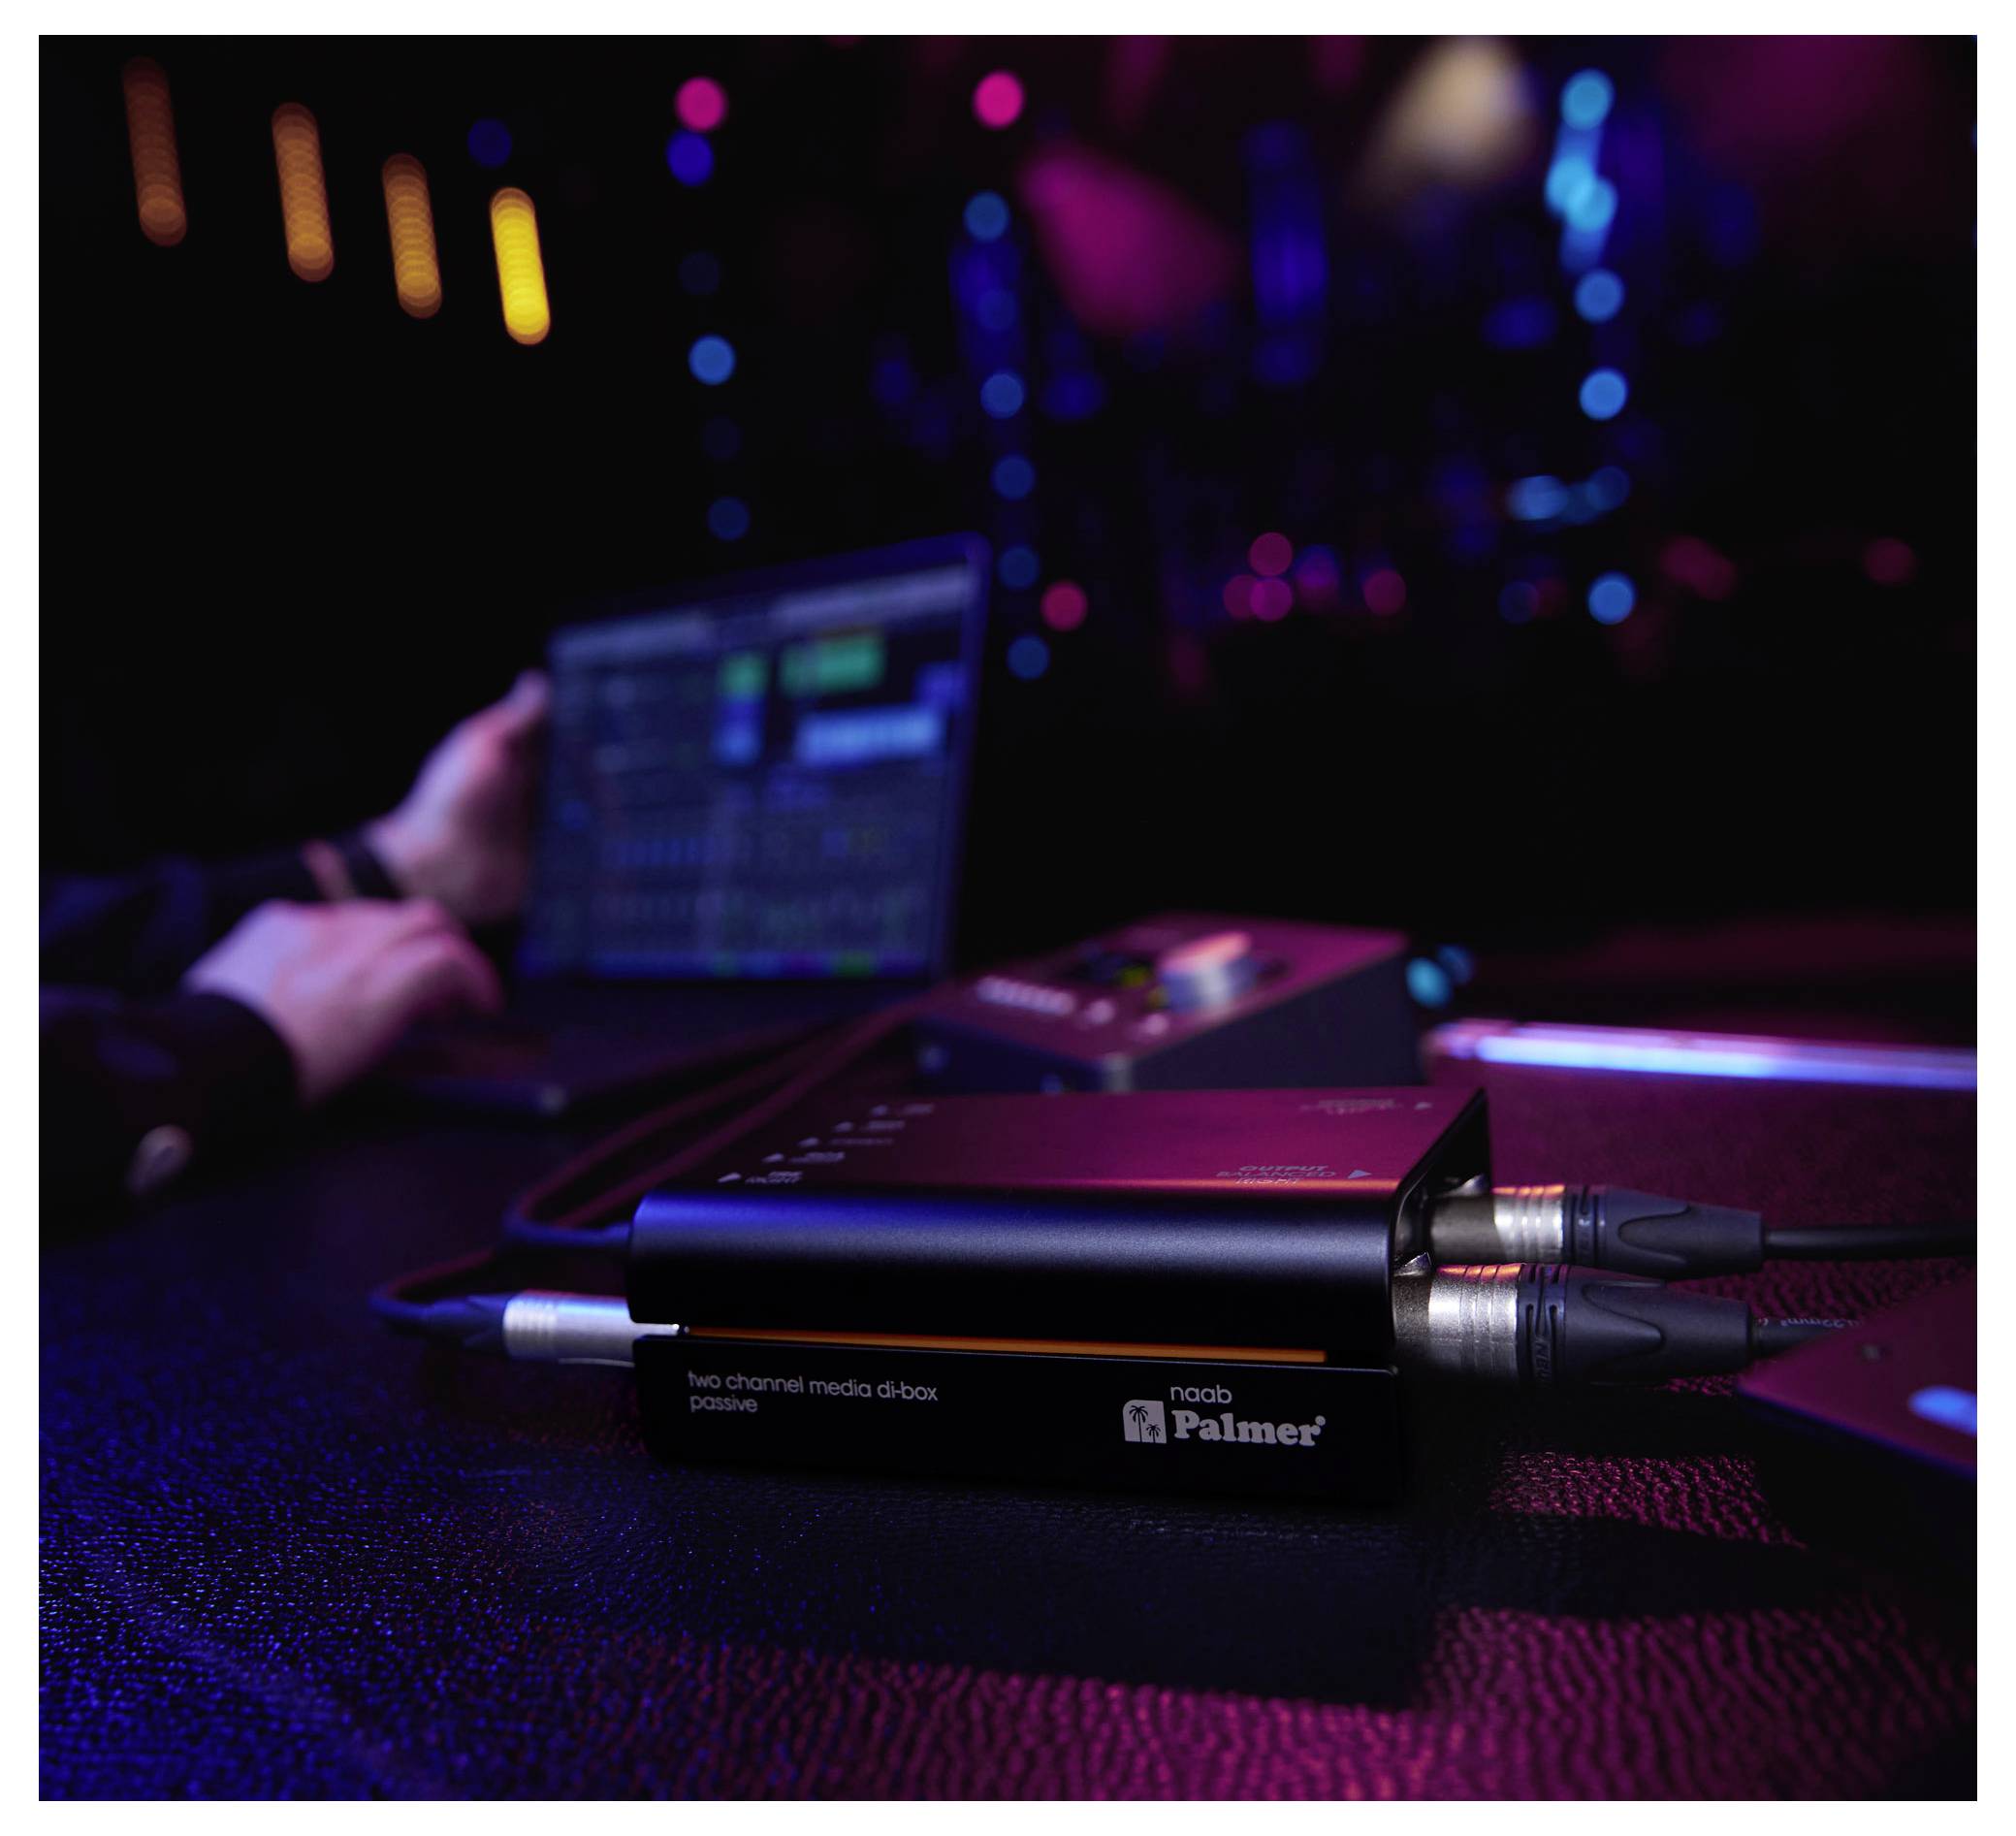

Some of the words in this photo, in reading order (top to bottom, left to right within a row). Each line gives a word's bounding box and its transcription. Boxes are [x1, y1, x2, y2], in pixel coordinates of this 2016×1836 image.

[688, 1370, 721, 1389] two
[725, 1372, 804, 1393] channel
[809, 1378, 872, 1398] media
[877, 1381, 939, 1401] di-box
[1169, 1384, 1232, 1403] naab
[689, 1394, 757, 1412] passive
